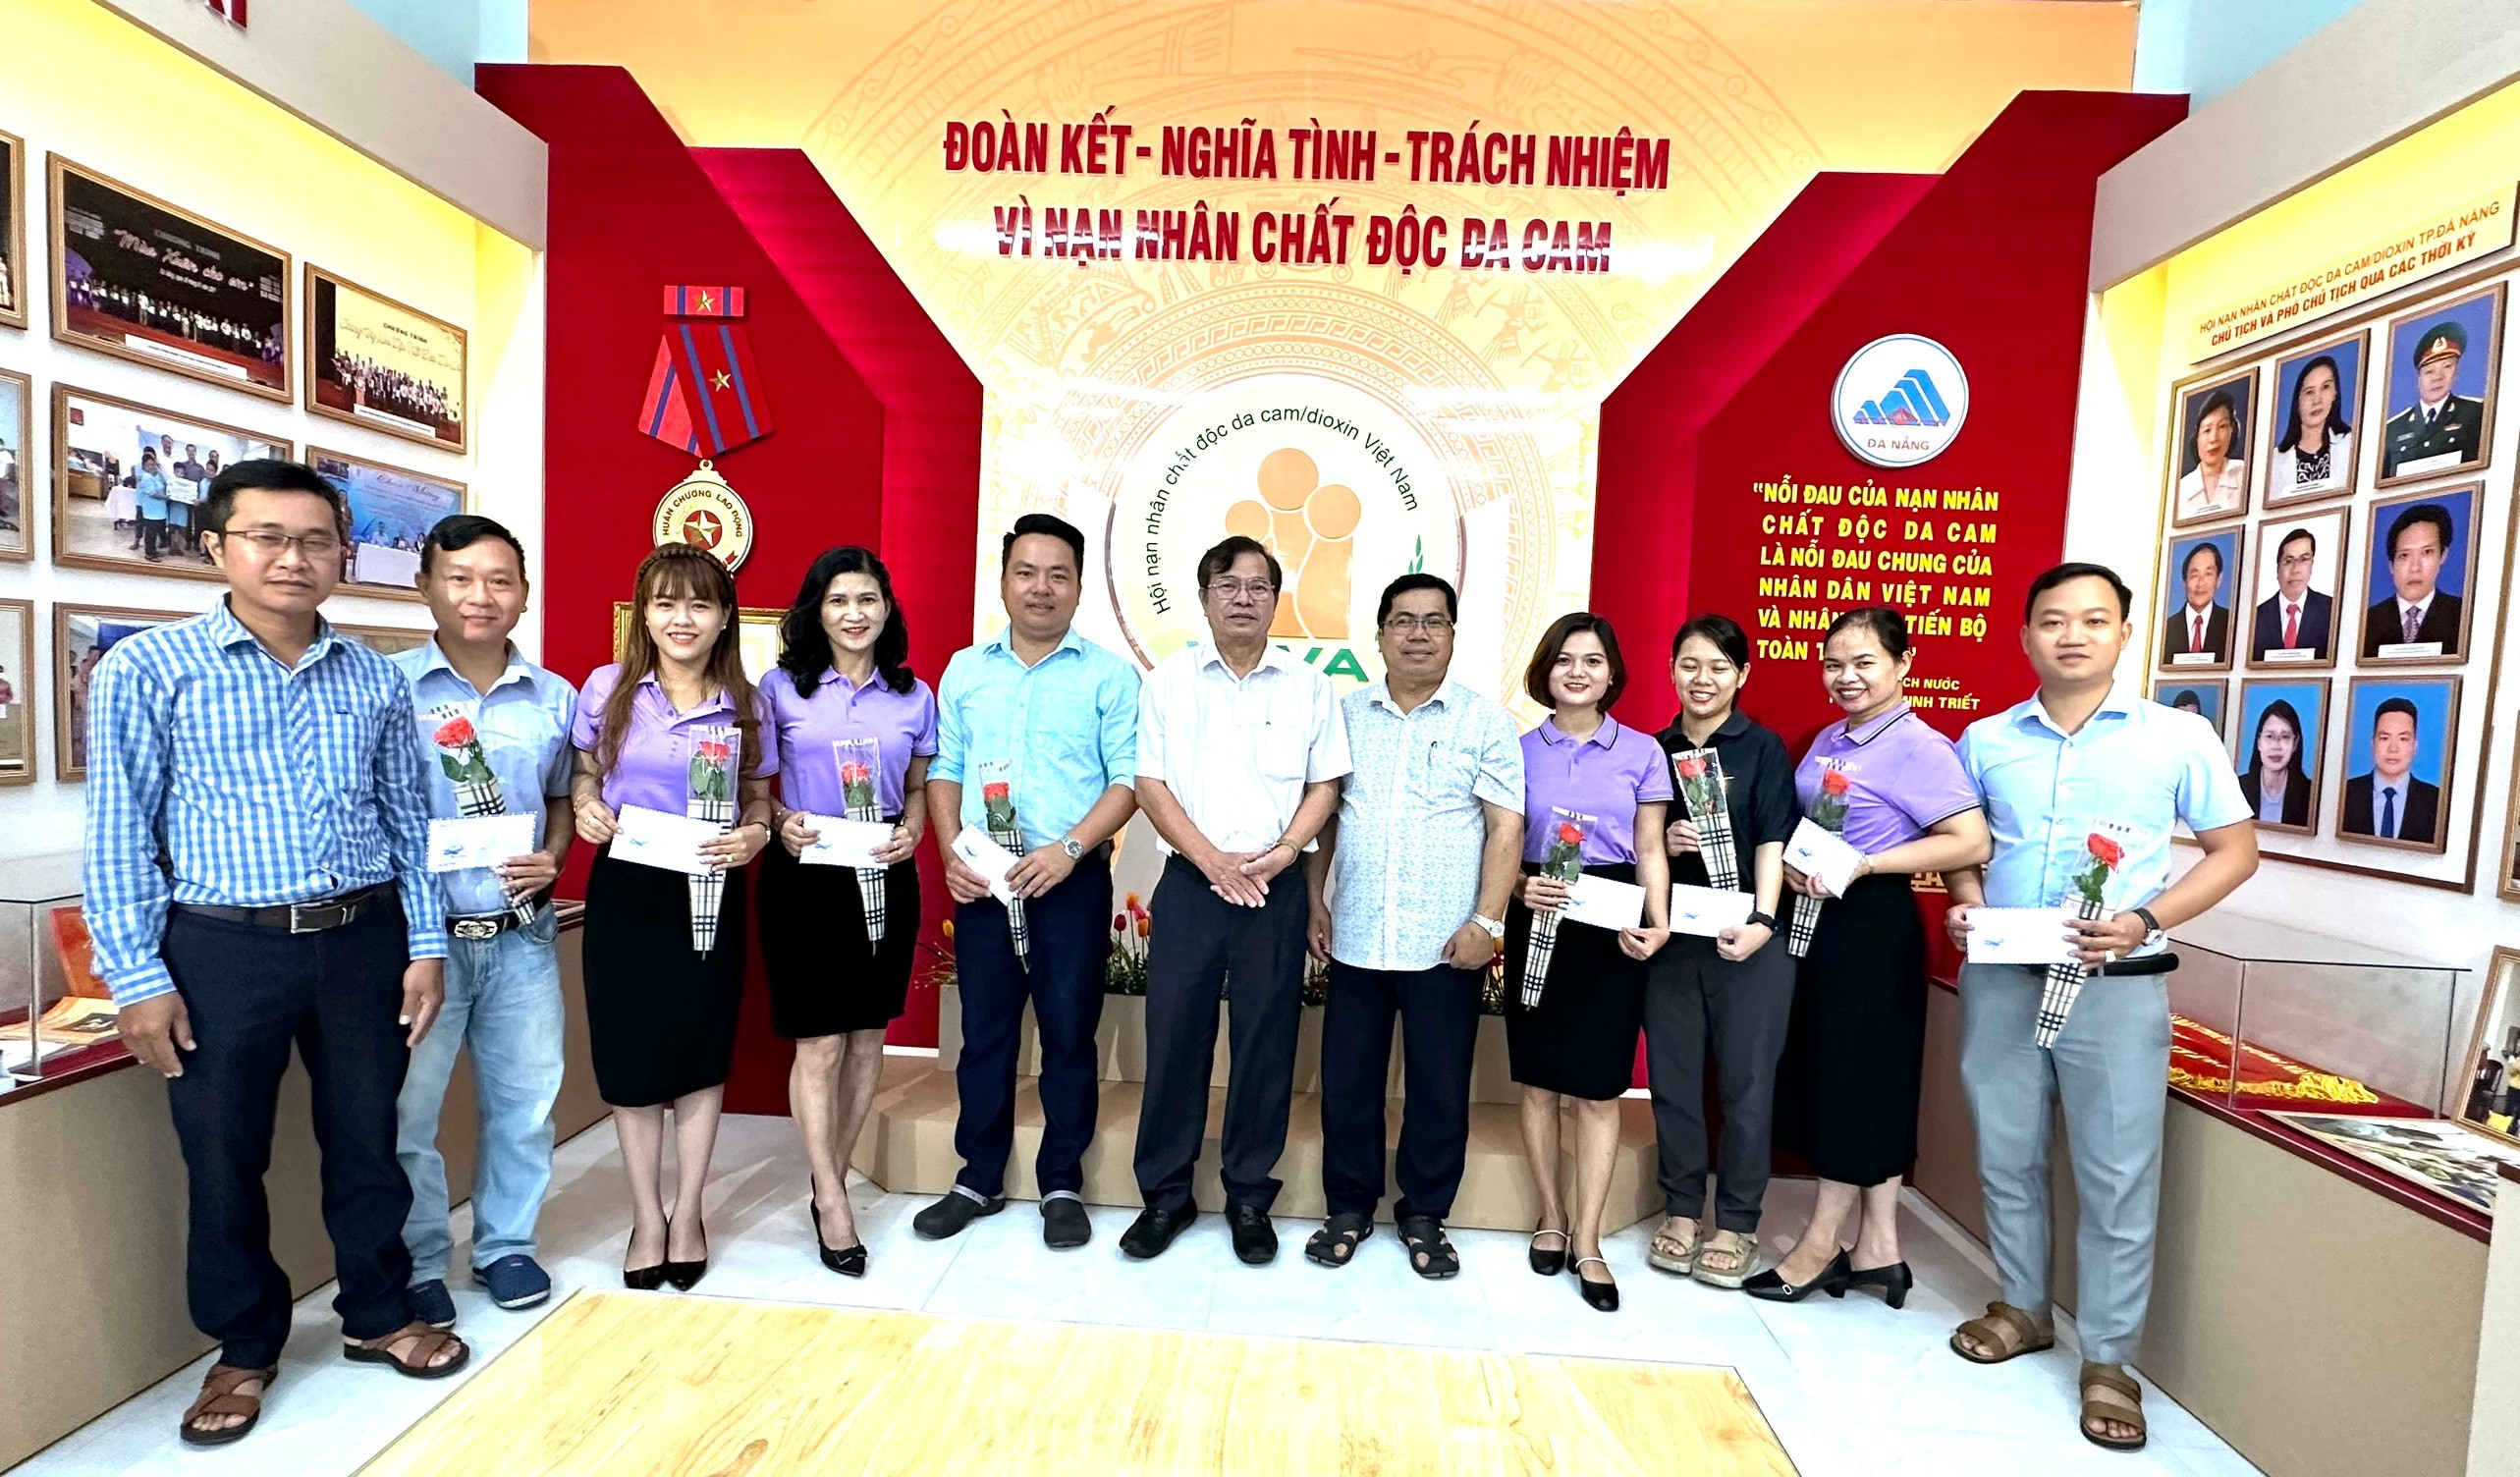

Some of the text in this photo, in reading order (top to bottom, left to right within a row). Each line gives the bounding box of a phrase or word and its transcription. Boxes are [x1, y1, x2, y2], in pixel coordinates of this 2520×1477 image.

[943, 108, 1049, 174] ĐOÀN
[1060, 104, 1133, 176] KẾT
[1161, 117, 1278, 180] NGHĨA
[1288, 117, 1377, 182] TÌNH
[1406, 119, 1537, 186] TRÁCH
[1545, 126, 1671, 198] NHIỆM
[993, 193, 1613, 275] VÌ NẠN NHÂN CHẤT ĐỘC DA CAM
[2326, 268, 2341, 284] DA
[2359, 269, 2385, 290] QUA
[1196, 424, 1229, 451] độc
[1232, 413, 1255, 430] da
[1261, 406, 1359, 440] cam/dioxin
[1364, 432, 1395, 467] Việt
[716, 493, 733, 510] LAO
[1390, 467, 1418, 511] Nam
[1803, 484, 1842, 506] ĐAU
[1848, 479, 1888, 507] CỦA
[1895, 487, 1938, 513] NẠN
[1943, 486, 2000, 512] NHÂN
[1145, 489, 1171, 535] nhân
[1762, 509, 1997, 544] CHẤT ĐỘC DA CAM
[1145, 542, 1162, 575] nạn
[1760, 539, 1994, 575] LÀ NỖI ĐAU CHUNG CỦA
[1147, 582, 1171, 615] Hội
[1759, 574, 1992, 608] NHÂN DÂN VIỆT NAM
[1758, 605, 1781, 629] VÀ
[1904, 609, 1952, 635] TIẾN
[1959, 613, 1988, 643] BỘ
[1756, 635, 1809, 661] TOÀN
[1923, 676, 1960, 690] NƯỚC
[1939, 691, 1981, 711] TRIẾT
